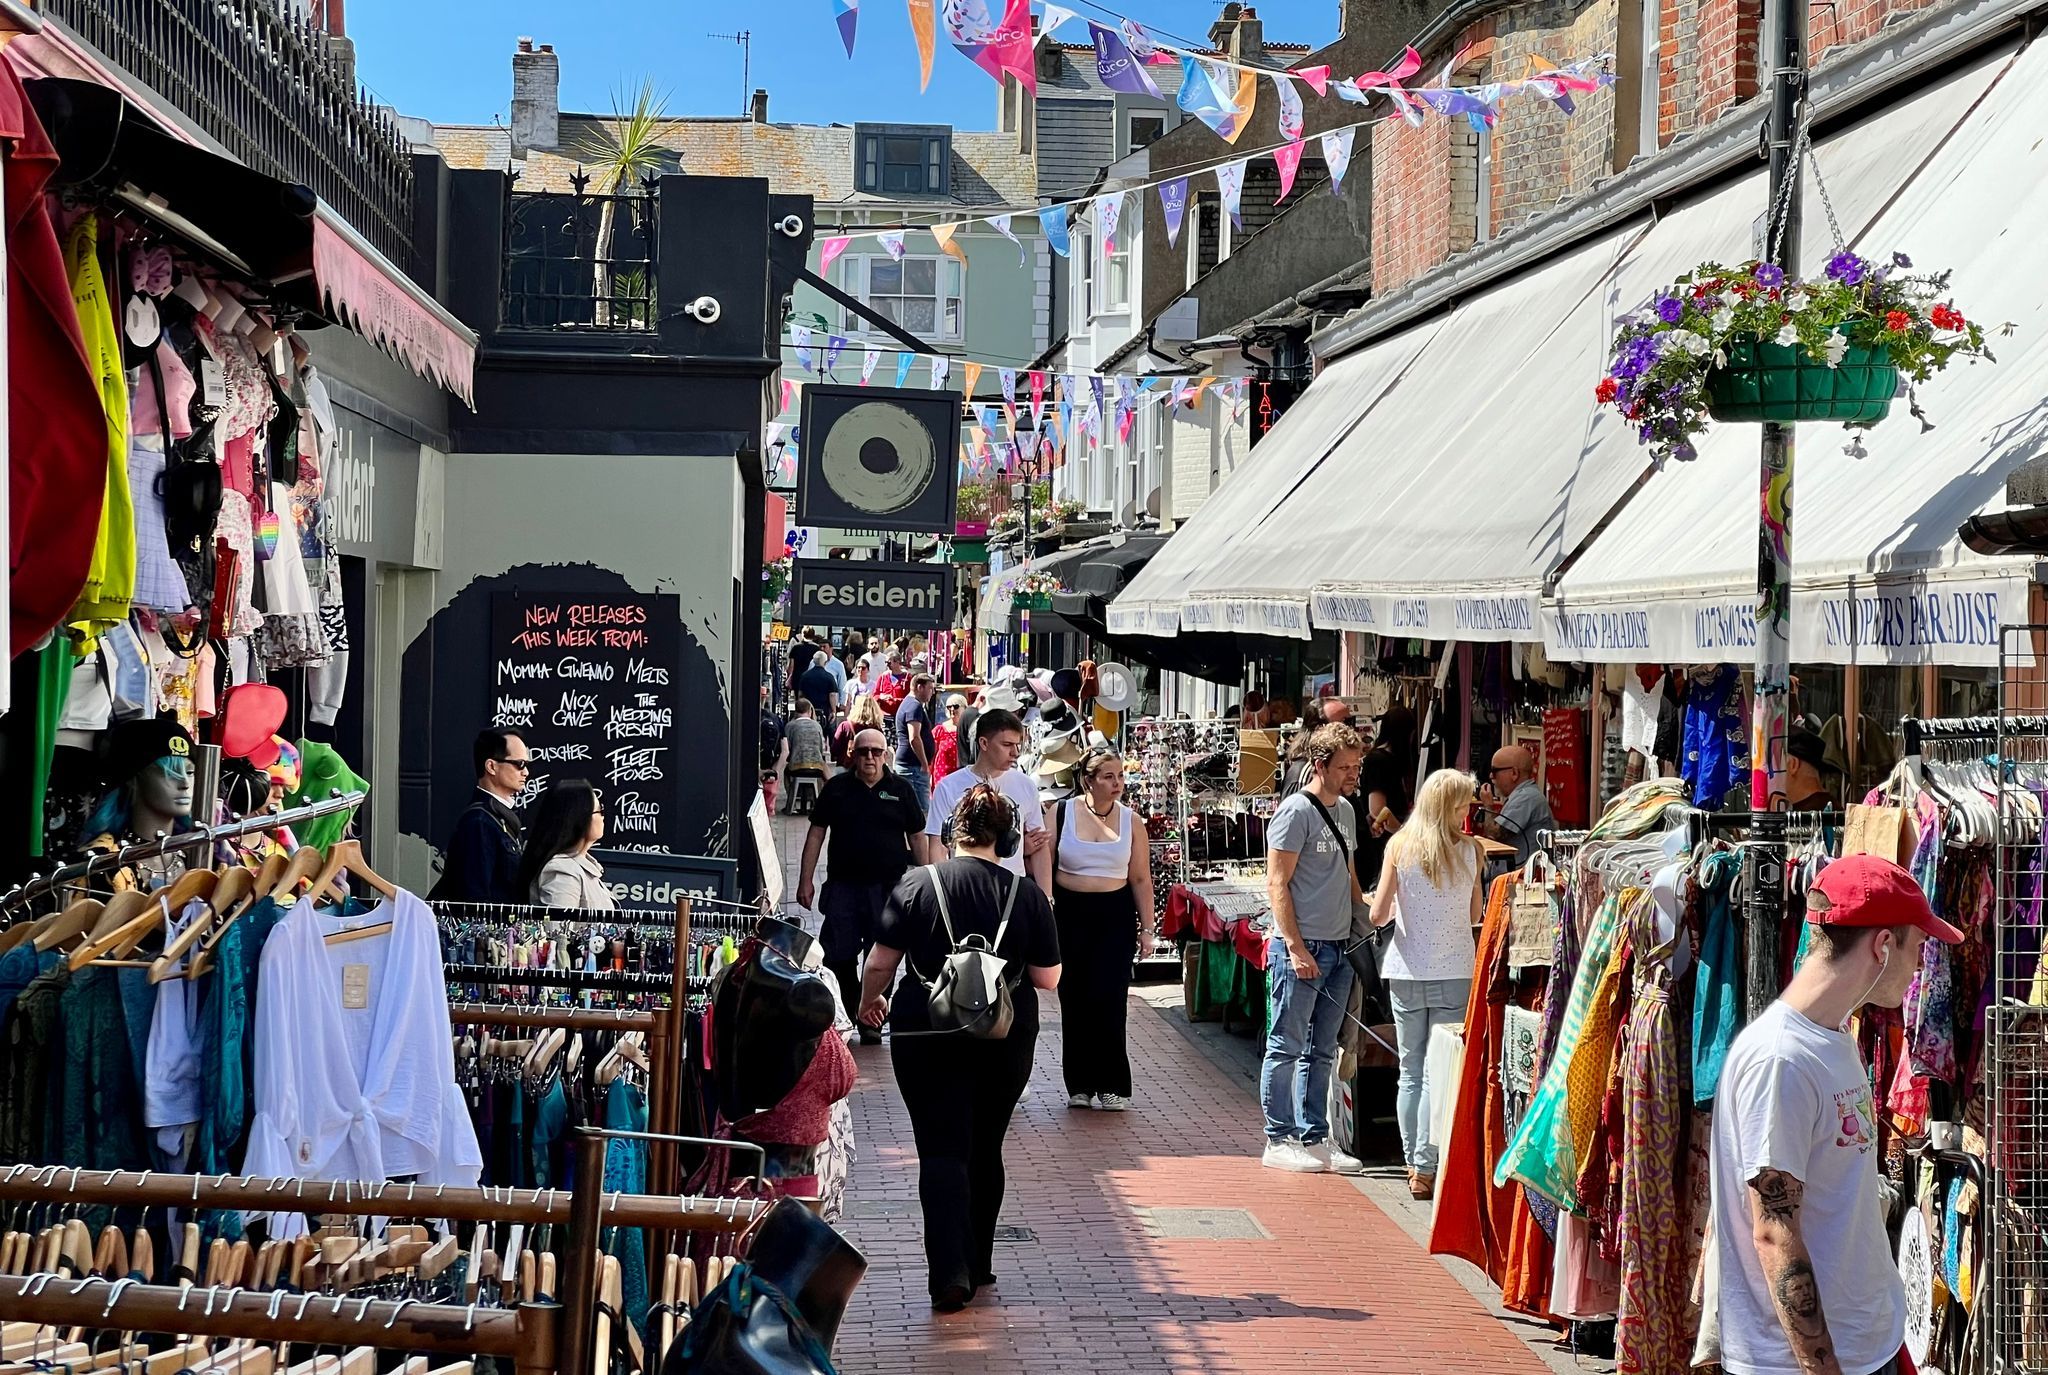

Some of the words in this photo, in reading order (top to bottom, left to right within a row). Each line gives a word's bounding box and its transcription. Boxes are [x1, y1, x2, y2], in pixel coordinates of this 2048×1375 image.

[336, 427, 375, 543] ident
[803, 580, 941, 609] resident
[526, 604, 561, 627] NEW
[567, 604, 648, 627] RELEASES
[1823, 595, 1903, 647] SNOOPERS
[1909, 590, 2000, 646] PARADISE
[512, 630, 551, 650] THIS
[556, 628, 599, 647] WEEK
[602, 629, 649, 650] FROM:
[1600, 610, 1650, 649] PARADISE
[559, 689, 599, 714] NICK
[634, 693, 659, 707] THE
[551, 709, 594, 728] CAVE
[609, 705, 672, 728] WEDDING
[602, 721, 665, 741] PRESENT
[604, 745, 669, 768] FLEET
[604, 765, 664, 786] FOXES
[614, 791, 660, 815] PAOLO
[1316, 841, 1327, 853] BE
